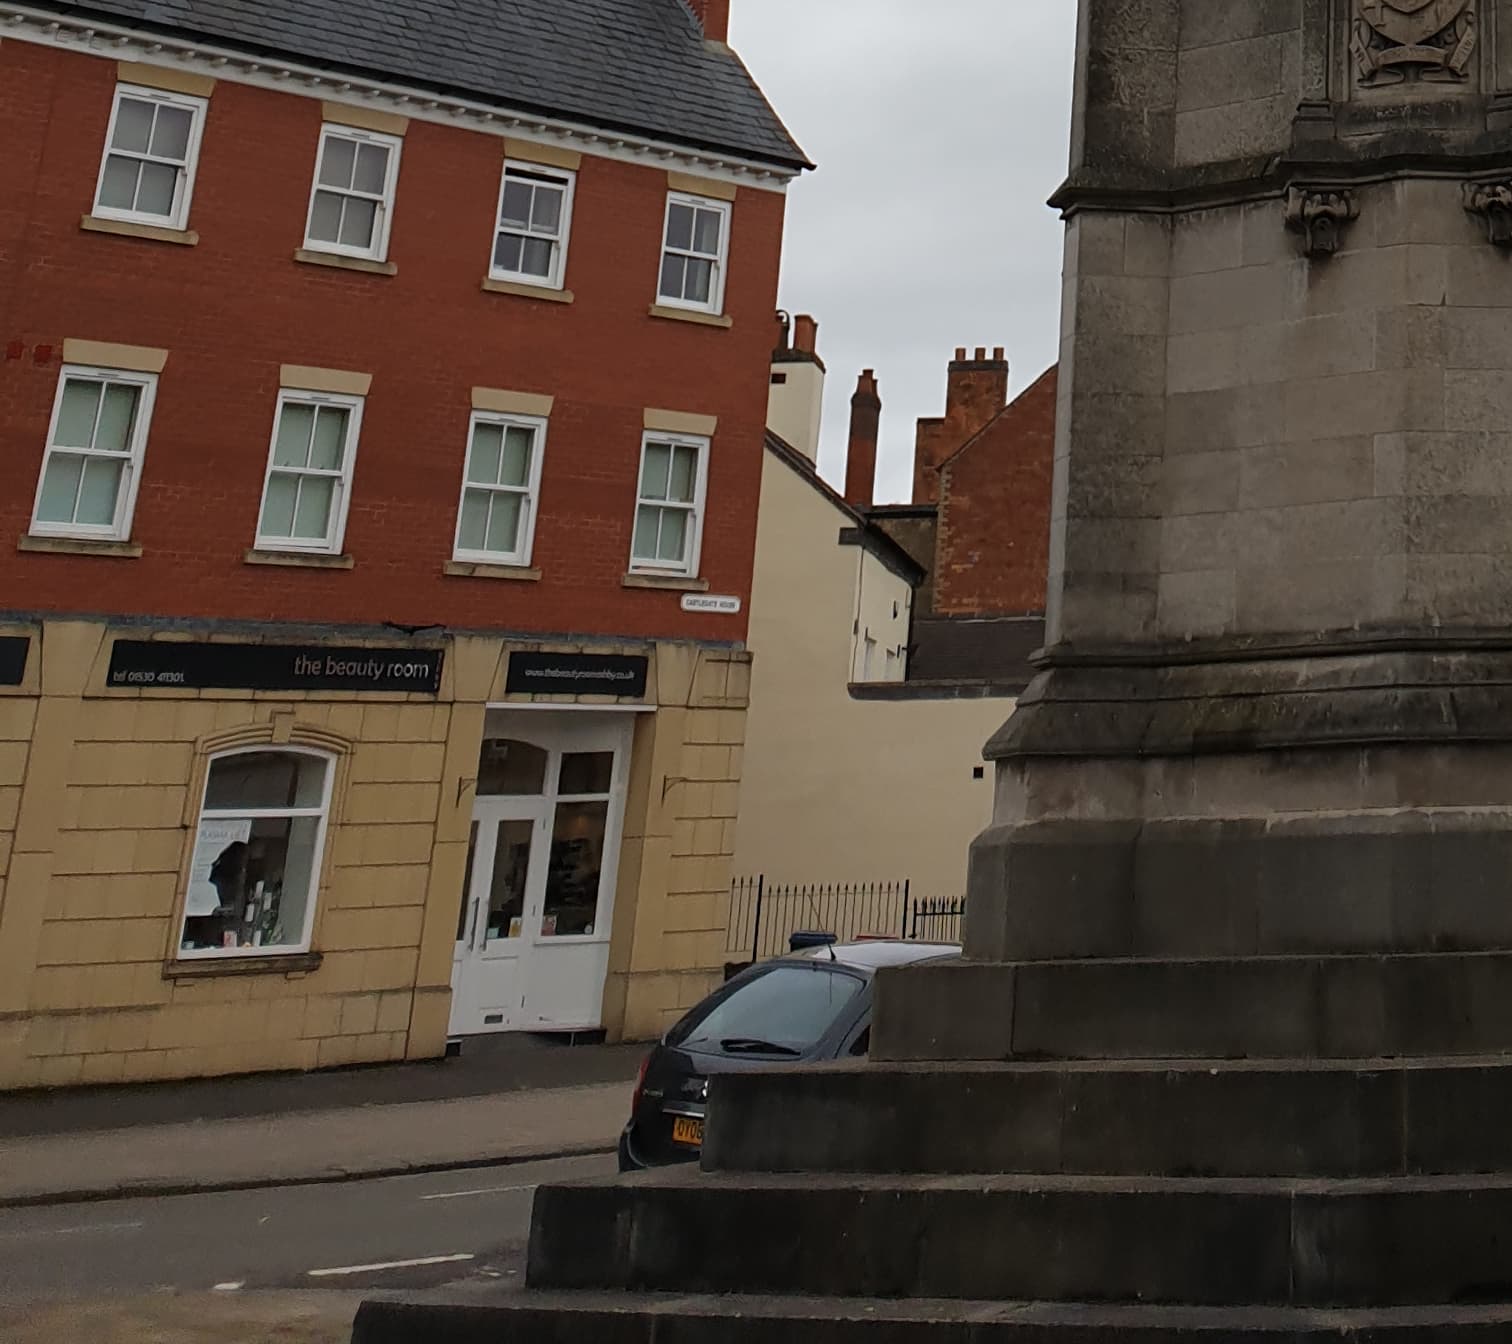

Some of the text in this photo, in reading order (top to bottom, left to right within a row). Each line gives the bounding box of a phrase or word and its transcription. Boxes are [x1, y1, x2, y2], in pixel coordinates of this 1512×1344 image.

[294, 654, 322, 675] the
[325, 655, 385, 680] beauty
[386, 663, 429, 679] room
